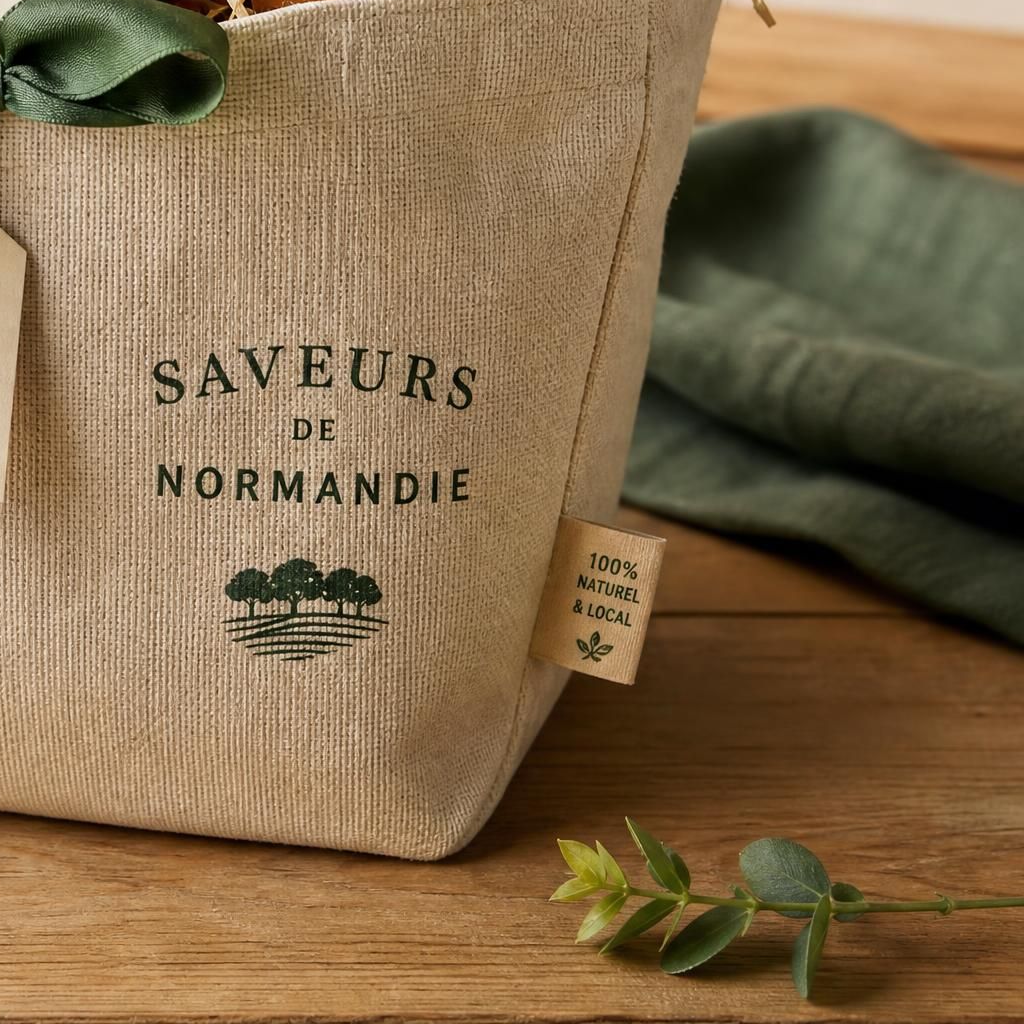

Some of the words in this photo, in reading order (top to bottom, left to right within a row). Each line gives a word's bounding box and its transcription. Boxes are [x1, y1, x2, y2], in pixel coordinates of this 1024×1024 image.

[152, 345, 477, 411] SAVEURS
[292, 418, 336, 441] DE
[157, 464, 471, 506] NORMANDIE
[590, 552, 638, 580] 100%
[577, 574, 640, 604] NATUREL
[573, 599, 583, 614] &
[587, 603, 632, 627] LOCAL
